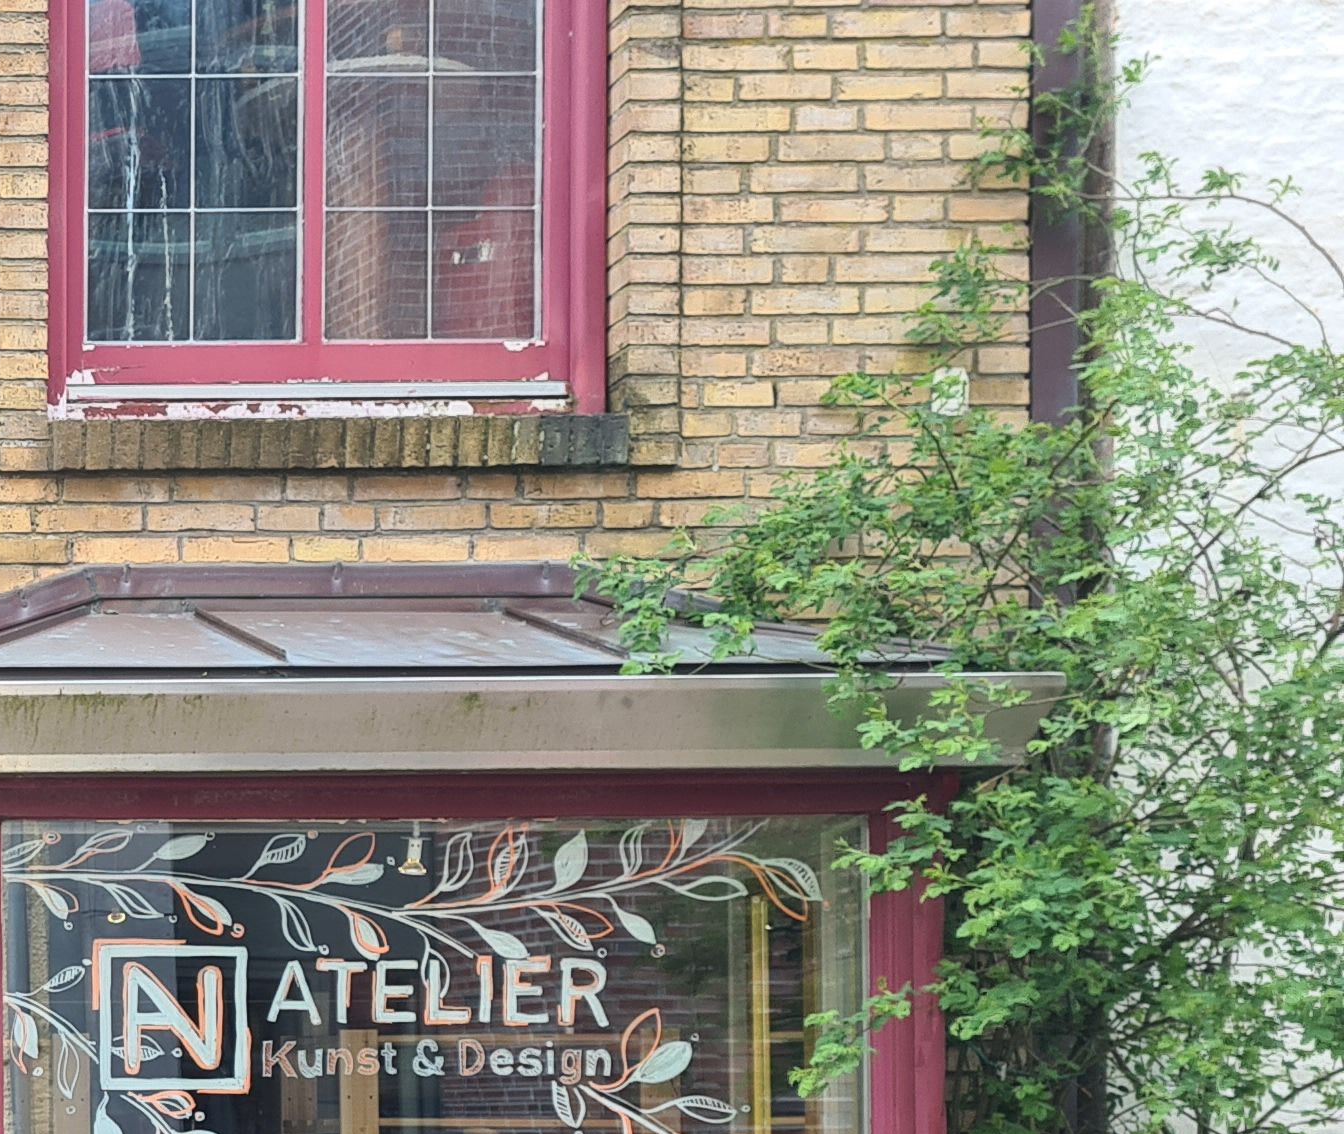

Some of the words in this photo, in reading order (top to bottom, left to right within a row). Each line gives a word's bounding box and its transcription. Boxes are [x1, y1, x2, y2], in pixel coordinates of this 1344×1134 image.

[266, 955, 610, 1027] ATELIER
[261, 1039, 398, 1079] Kunst
[412, 1038, 446, 1078] &
[457, 1039, 612, 1085] Design
